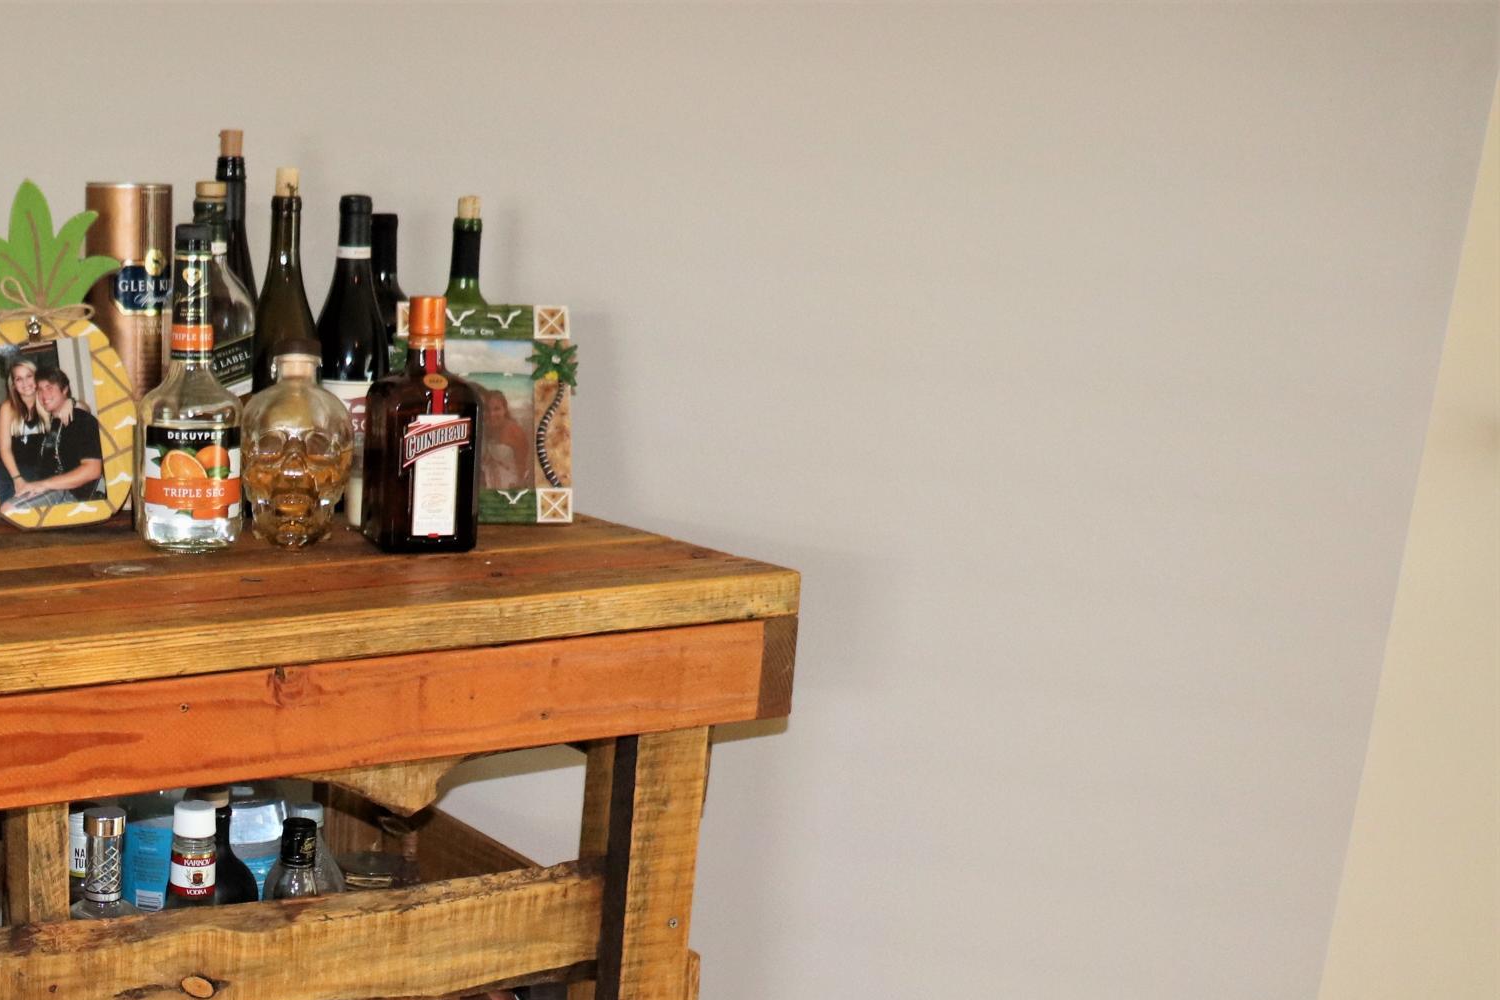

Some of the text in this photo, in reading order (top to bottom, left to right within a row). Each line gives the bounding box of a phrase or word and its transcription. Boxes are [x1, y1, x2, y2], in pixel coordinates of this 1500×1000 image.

[118, 279, 156, 292] GLEN
[220, 351, 251, 368] LABEL
[405, 423, 468, 460] COINTREAU
[163, 487, 225, 498] TRIPLE SEC
